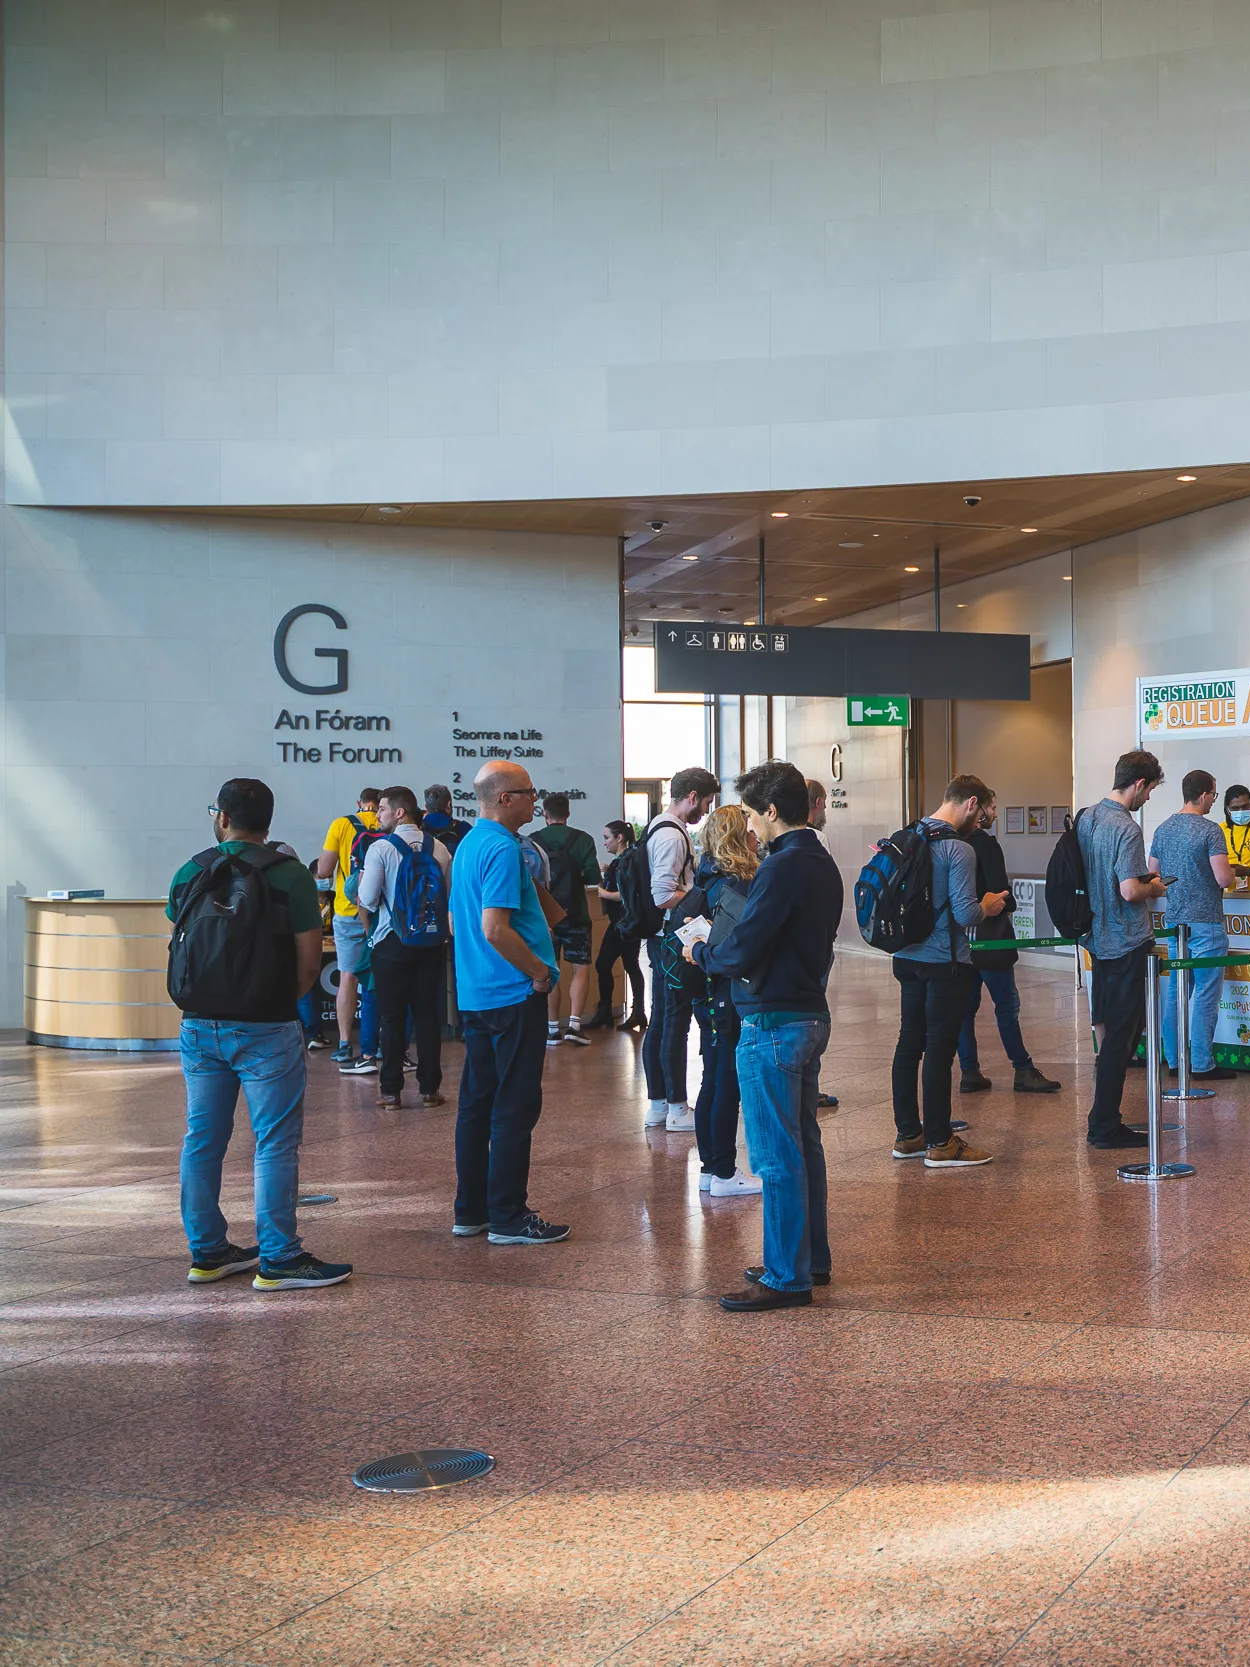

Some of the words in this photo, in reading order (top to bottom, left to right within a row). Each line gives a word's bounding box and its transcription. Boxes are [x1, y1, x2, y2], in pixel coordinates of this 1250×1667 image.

[273, 603, 348, 695] G
[1143, 681, 1235, 703] REGISTRATION
[452, 711, 459, 722] 1
[1167, 699, 1235, 728] QUEUE
[274, 709, 309, 730] An
[315, 709, 390, 731] Fóram
[452, 729, 500, 740] Seomra
[503, 731, 519, 740] na
[520, 729, 543, 740] Life
[276, 742, 322, 763] The
[329, 742, 402, 764] Forum
[453, 747, 476, 757] The
[480, 747, 512, 759] Liffey
[514, 746, 543, 757] Suite
[830, 743, 843, 783] G
[453, 772, 461, 783] 2
[454, 806, 476, 817] The
[1014, 916, 1034, 928] GREEN
[1018, 930, 1030, 939] TAG
[1231, 985, 1249, 996] 2022
[321, 1001, 336, 1009] TH
